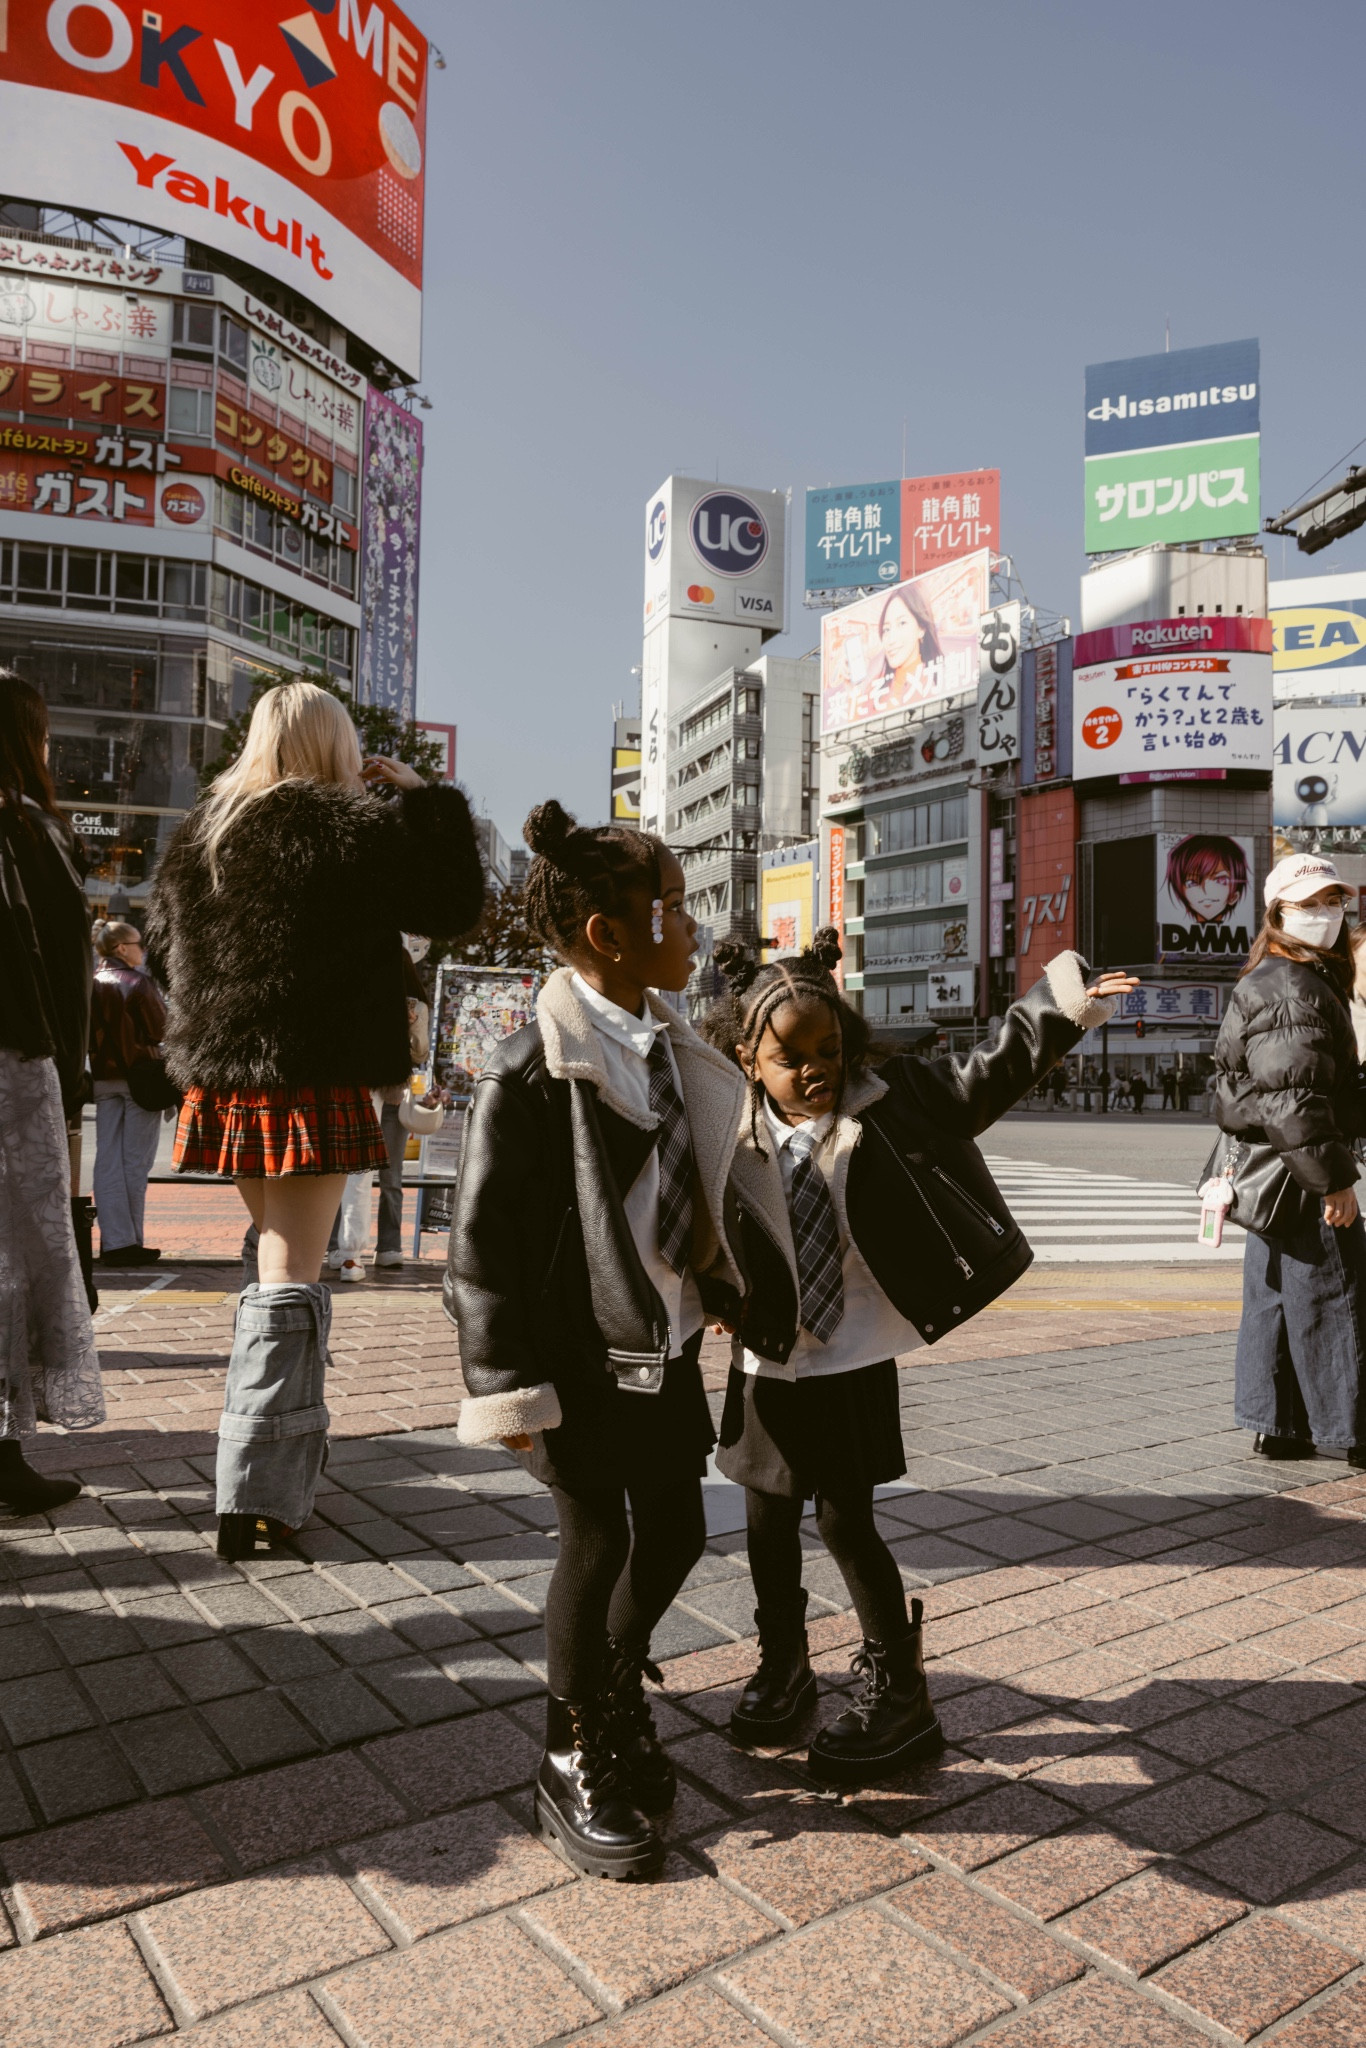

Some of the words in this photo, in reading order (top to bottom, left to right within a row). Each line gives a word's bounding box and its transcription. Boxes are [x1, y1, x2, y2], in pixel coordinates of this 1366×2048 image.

[308, 0, 419, 113] ME
[0, 0, 333, 177] OKYO
[116, 140, 334, 281] Yakult
[46, 292, 157, 338] しゃぶ葉
[245, 295, 362, 387] しゃぶしゃぶバイキング
[289, 367, 354, 434] しゃぶ葉
[1087, 383, 1256, 421] Hisamitsu
[94, 435, 181, 472] ガスト
[216, 401, 330, 487] コンタクト
[33, 472, 147, 521] ガスト
[166, 499, 201, 514] ガスト
[922, 493, 981, 523] 龍角散
[1095, 467, 1249, 522] サロンパス
[301, 501, 350, 545] ガスト
[649, 509, 667, 551] UC
[699, 510, 761, 556] UC
[825, 503, 882, 534] 龍角散
[914, 521, 992, 550] ダイレクト
[817, 531, 892, 560] ダイレクト
[740, 595, 773, 613] VISA
[1132, 624, 1213, 646] Rakuten
[1272, 621, 1360, 653] EA
[979, 608, 1017, 757] もんじゃ
[1078, 671, 1106, 681] Rakuten
[1127, 683, 1237, 705] 「らくてんで
[1135, 707, 1265, 728] かう？」と2歳も
[1095, 726, 1108, 745] 2
[1142, 730, 1228, 752] 言い始め
[1149, 771, 1175, 780] Rakuten
[1176, 770, 1196, 779] Vision
[1020, 874, 1071, 955] クスリ
[1160, 923, 1251, 955] DMM
[1117, 988, 1220, 1015] 盛堂書
